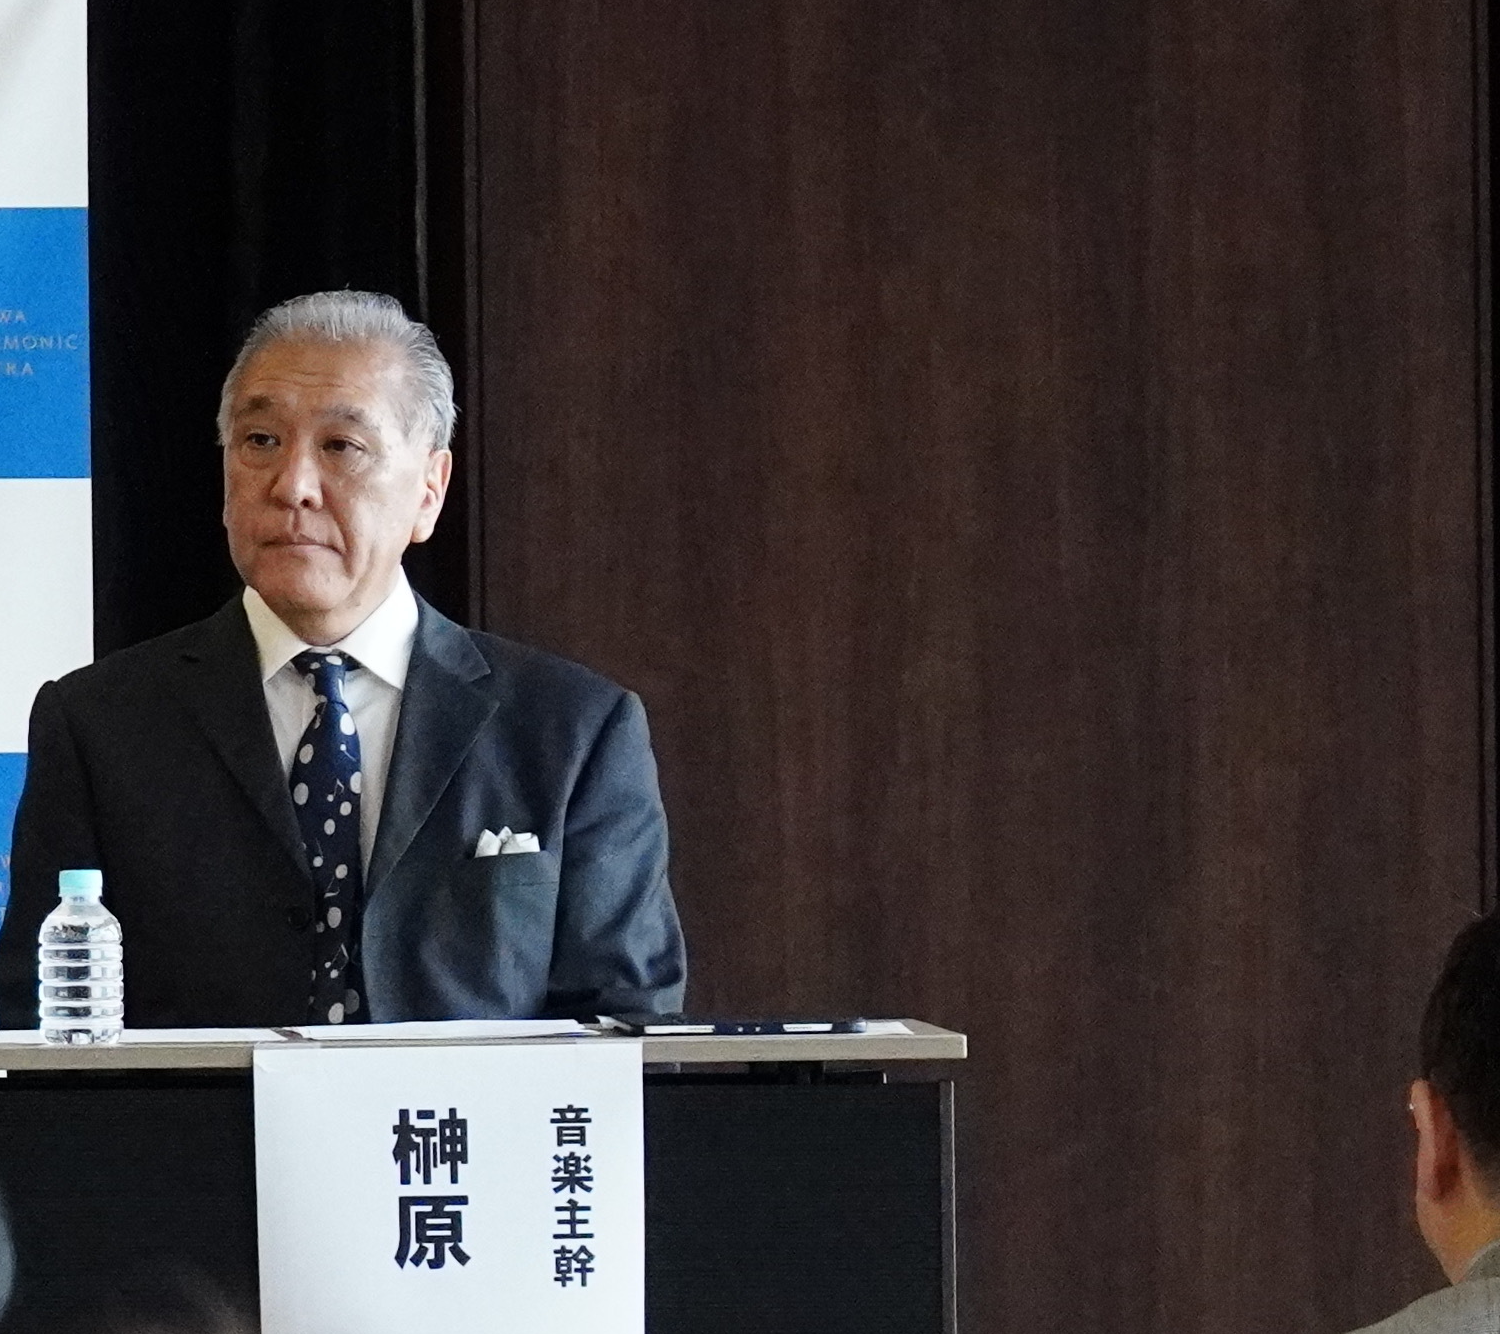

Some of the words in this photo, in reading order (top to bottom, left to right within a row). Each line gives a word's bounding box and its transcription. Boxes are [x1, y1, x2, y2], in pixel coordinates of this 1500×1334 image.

[392, 1107, 471, 1270] 榊原
[550, 1104, 595, 1287] 音楽主幹
